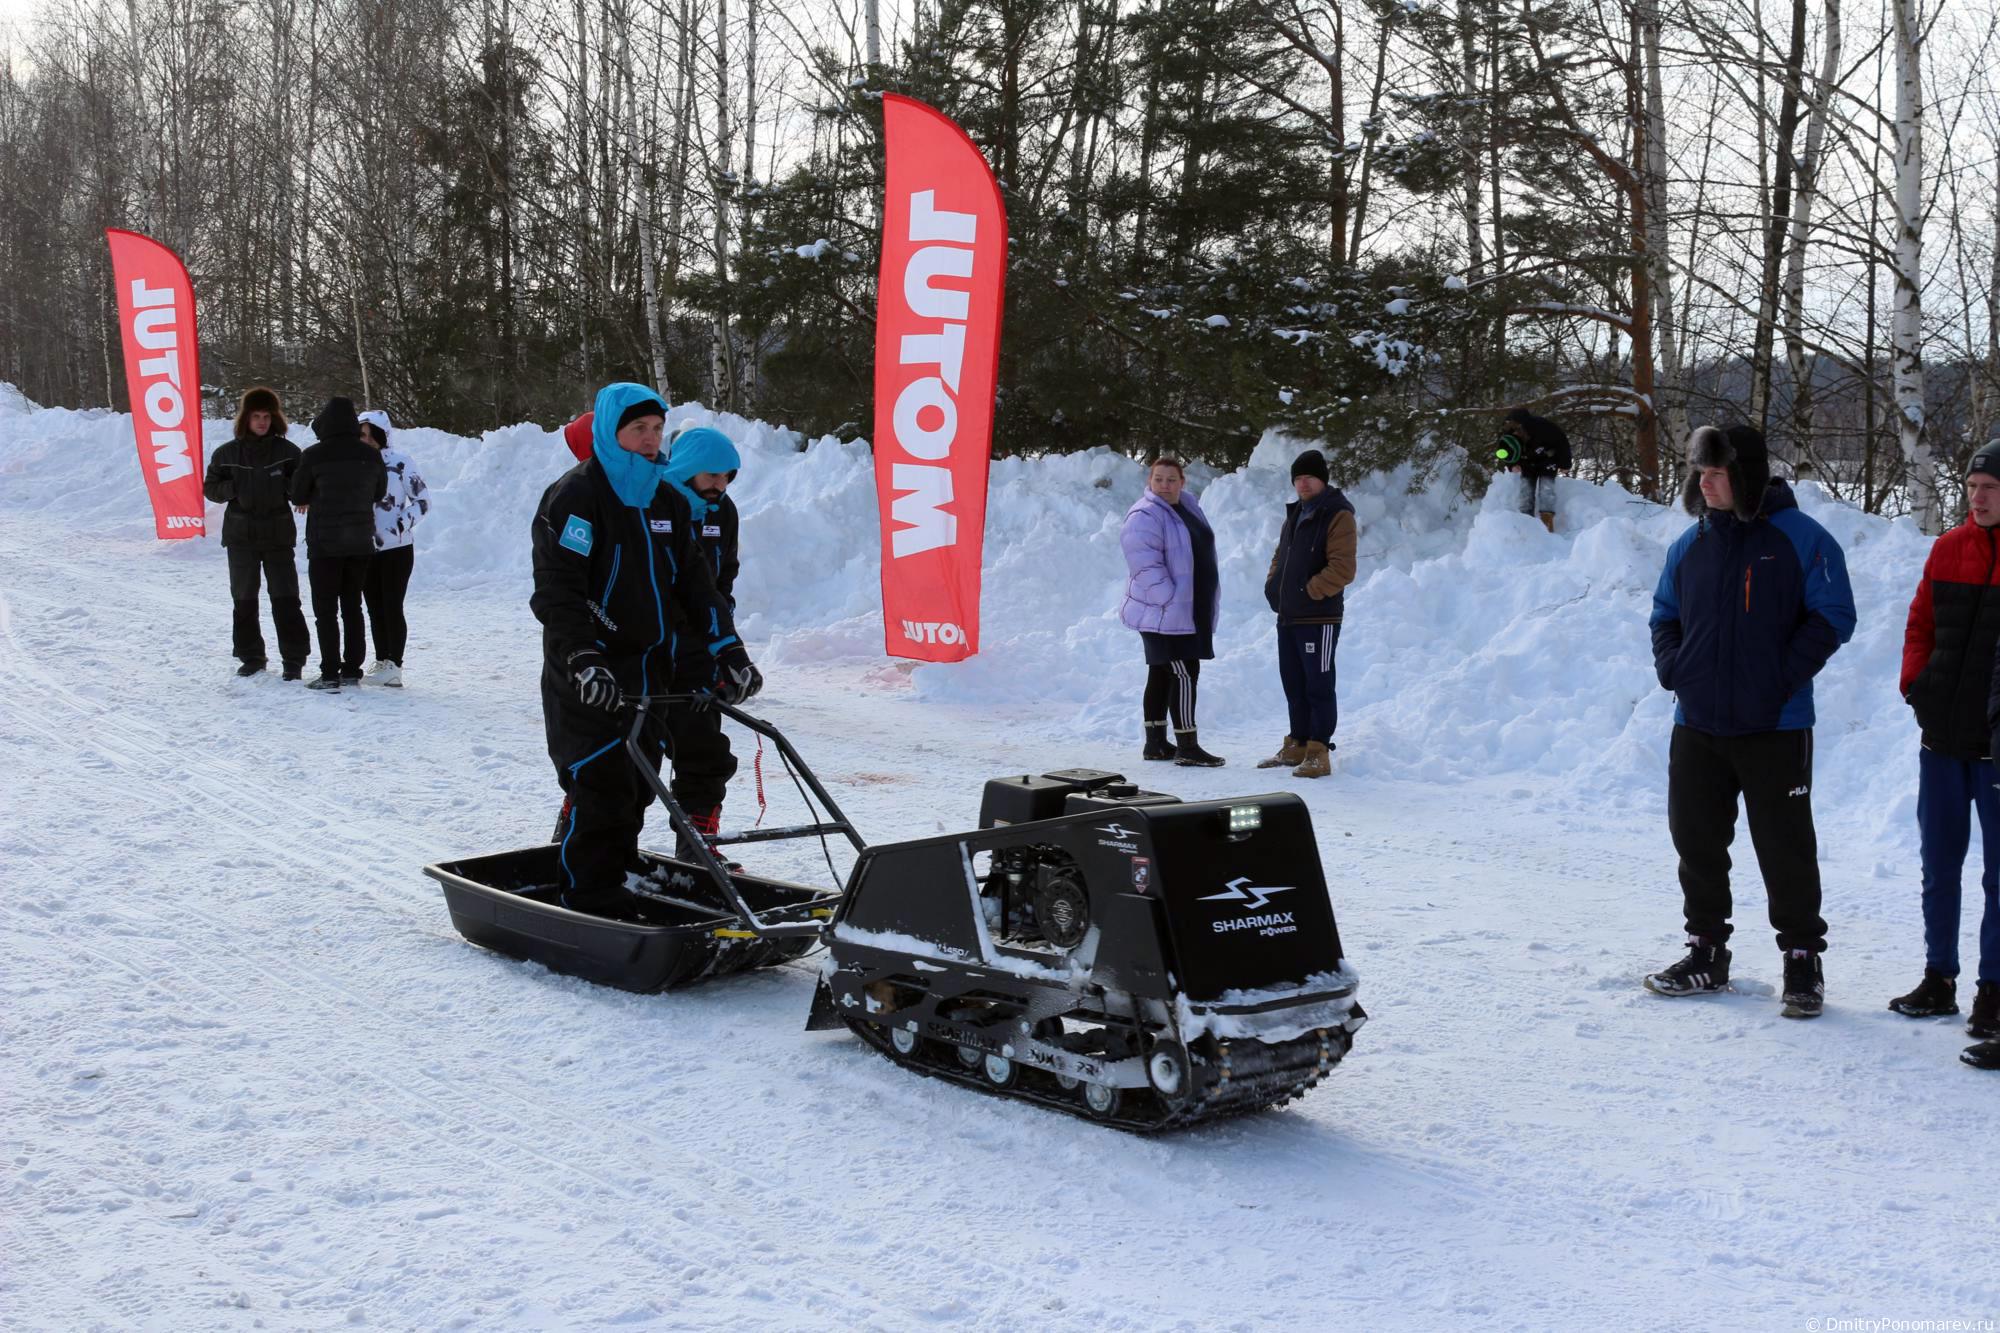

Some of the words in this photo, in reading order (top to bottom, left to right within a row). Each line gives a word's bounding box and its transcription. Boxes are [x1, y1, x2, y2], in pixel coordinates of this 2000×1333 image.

[1098, 839, 1138, 849] SHARMAX
[1212, 911, 1295, 933] SHARMAX
[1260, 925, 1297, 937] POWER
